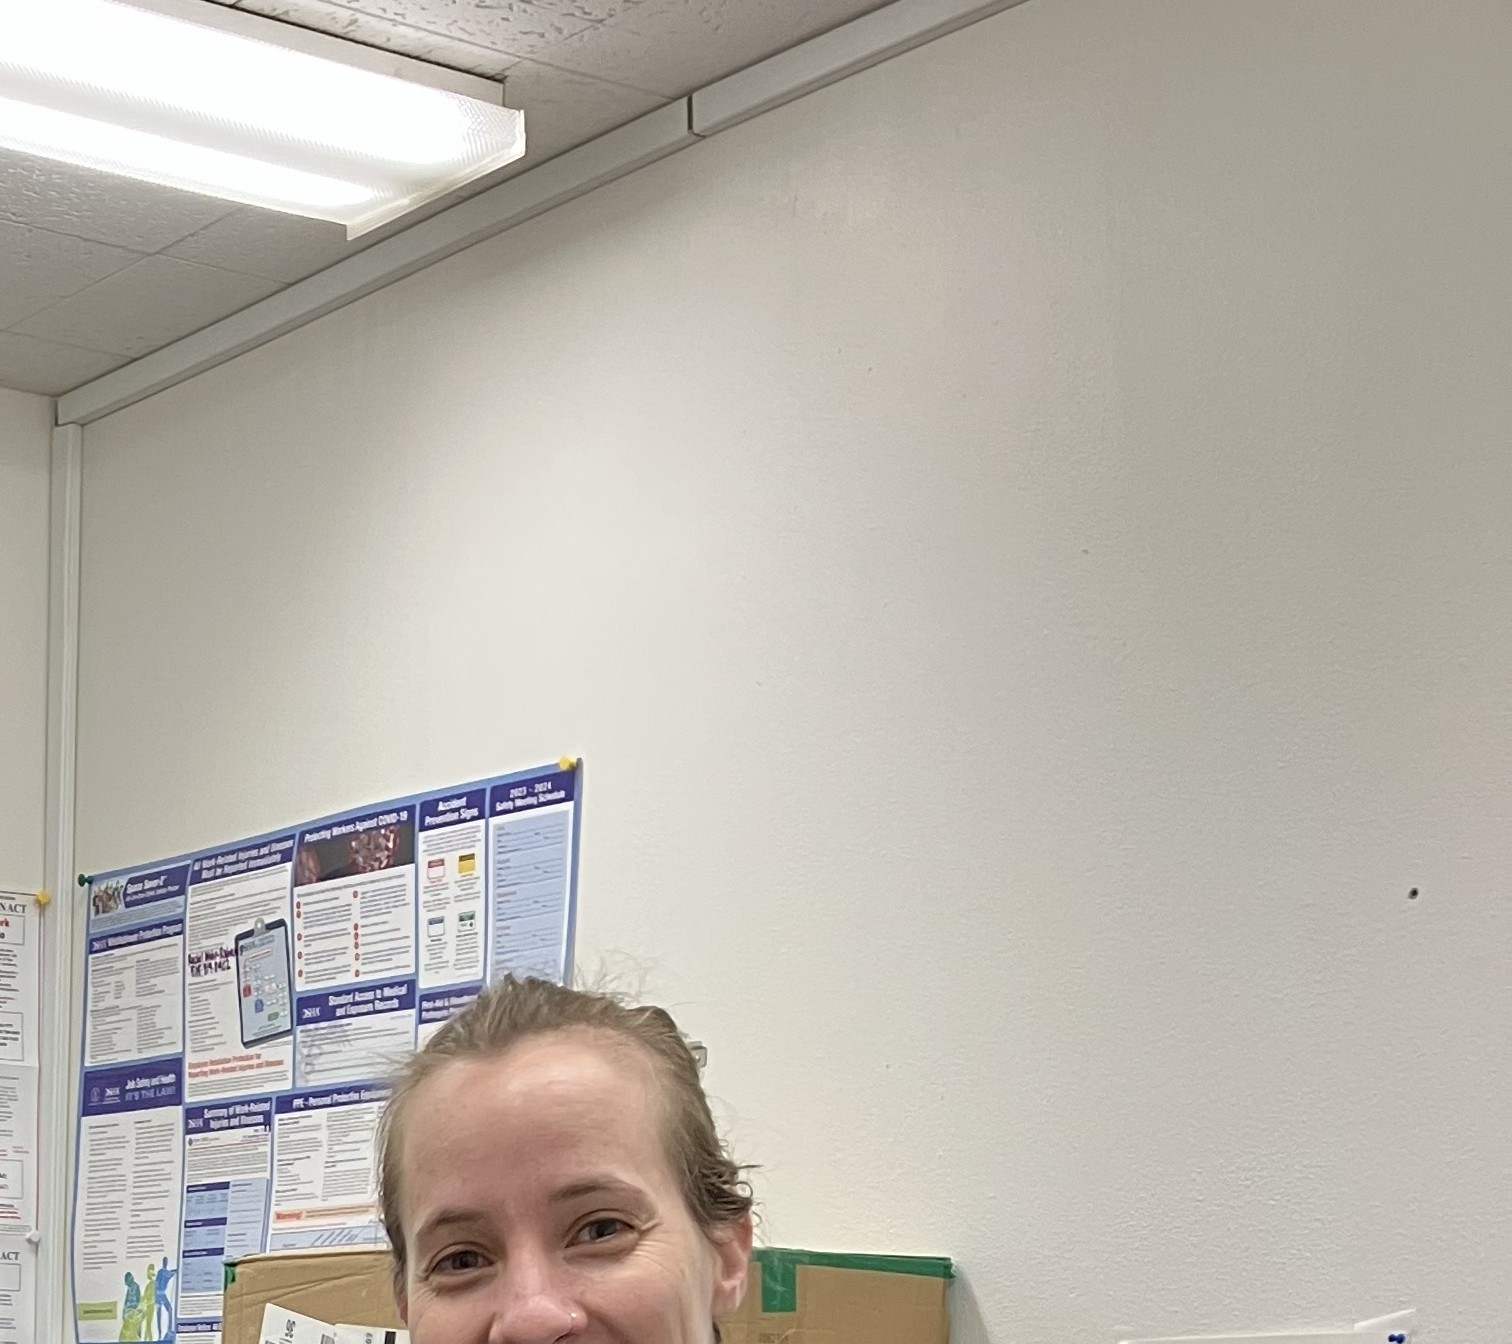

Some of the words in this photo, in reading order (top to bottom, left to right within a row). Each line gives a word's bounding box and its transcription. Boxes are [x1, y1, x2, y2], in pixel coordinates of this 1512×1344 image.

[438, 797, 467, 811] Accident
[495, 800, 514, 811] Safety
[355, 818, 377, 831] Against
[378, 810, 408, 826] COVID-19
[424, 810, 459, 826] Prevention
[460, 807, 479, 820] Signs
[8, 904, 27, 914] ACT
[141, 1088, 155, 1099] THE
[0, 1251, 20, 1261] ACT
